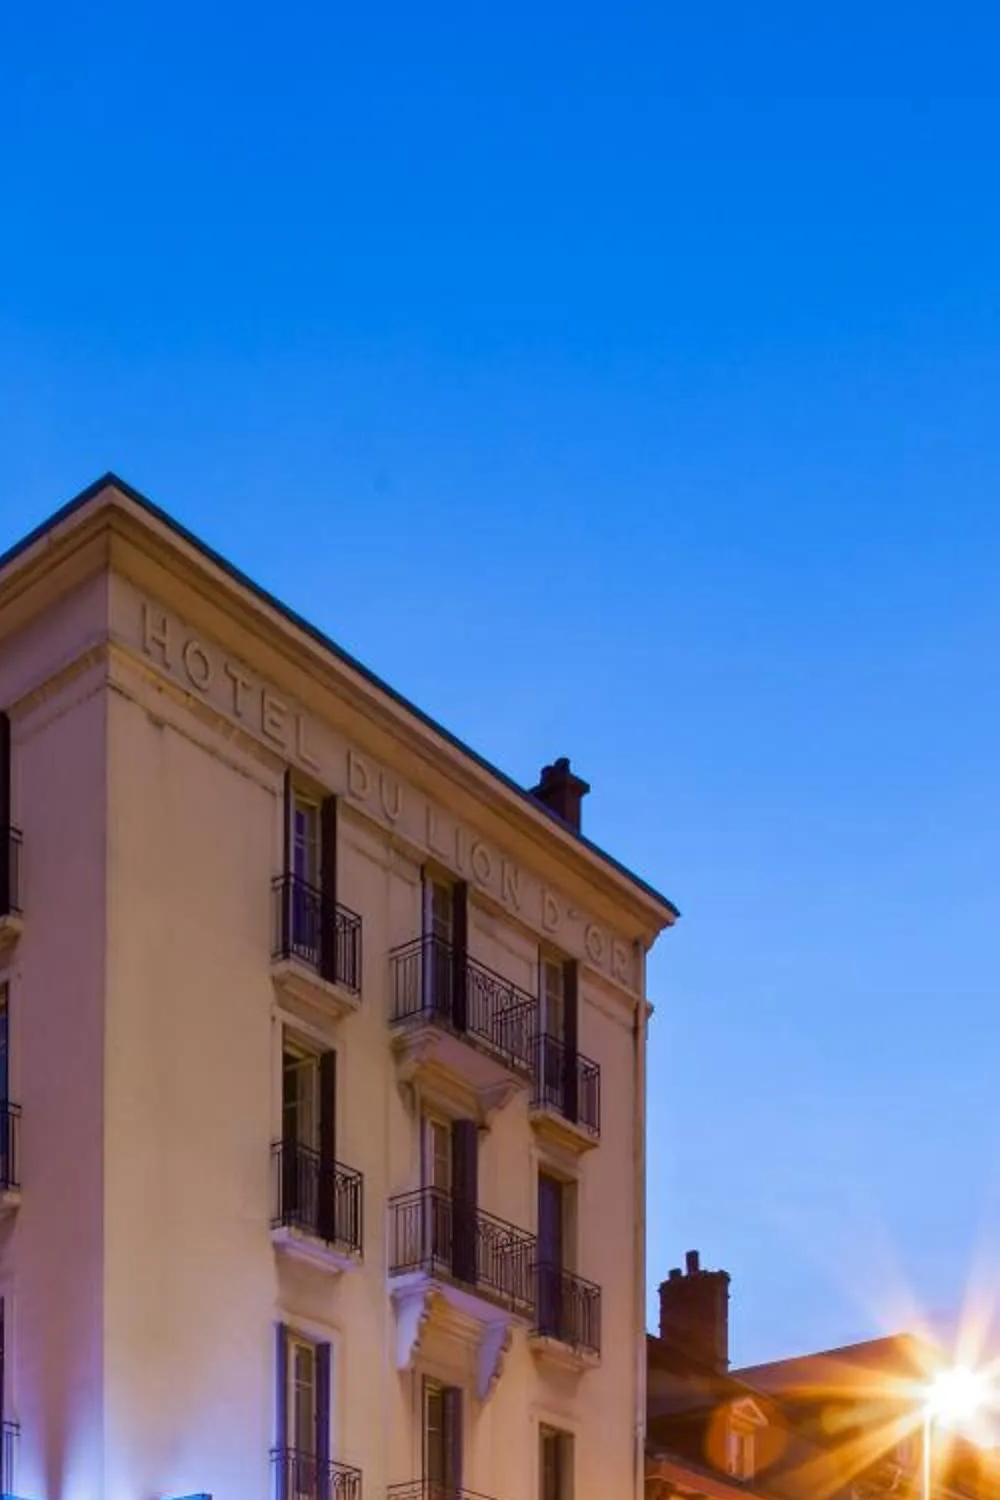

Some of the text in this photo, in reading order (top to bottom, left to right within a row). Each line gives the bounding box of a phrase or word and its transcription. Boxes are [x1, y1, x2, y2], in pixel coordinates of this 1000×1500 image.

[141, 601, 320, 775] HOTEL
[346, 747, 400, 826] DU
[425, 805, 522, 913] LION
